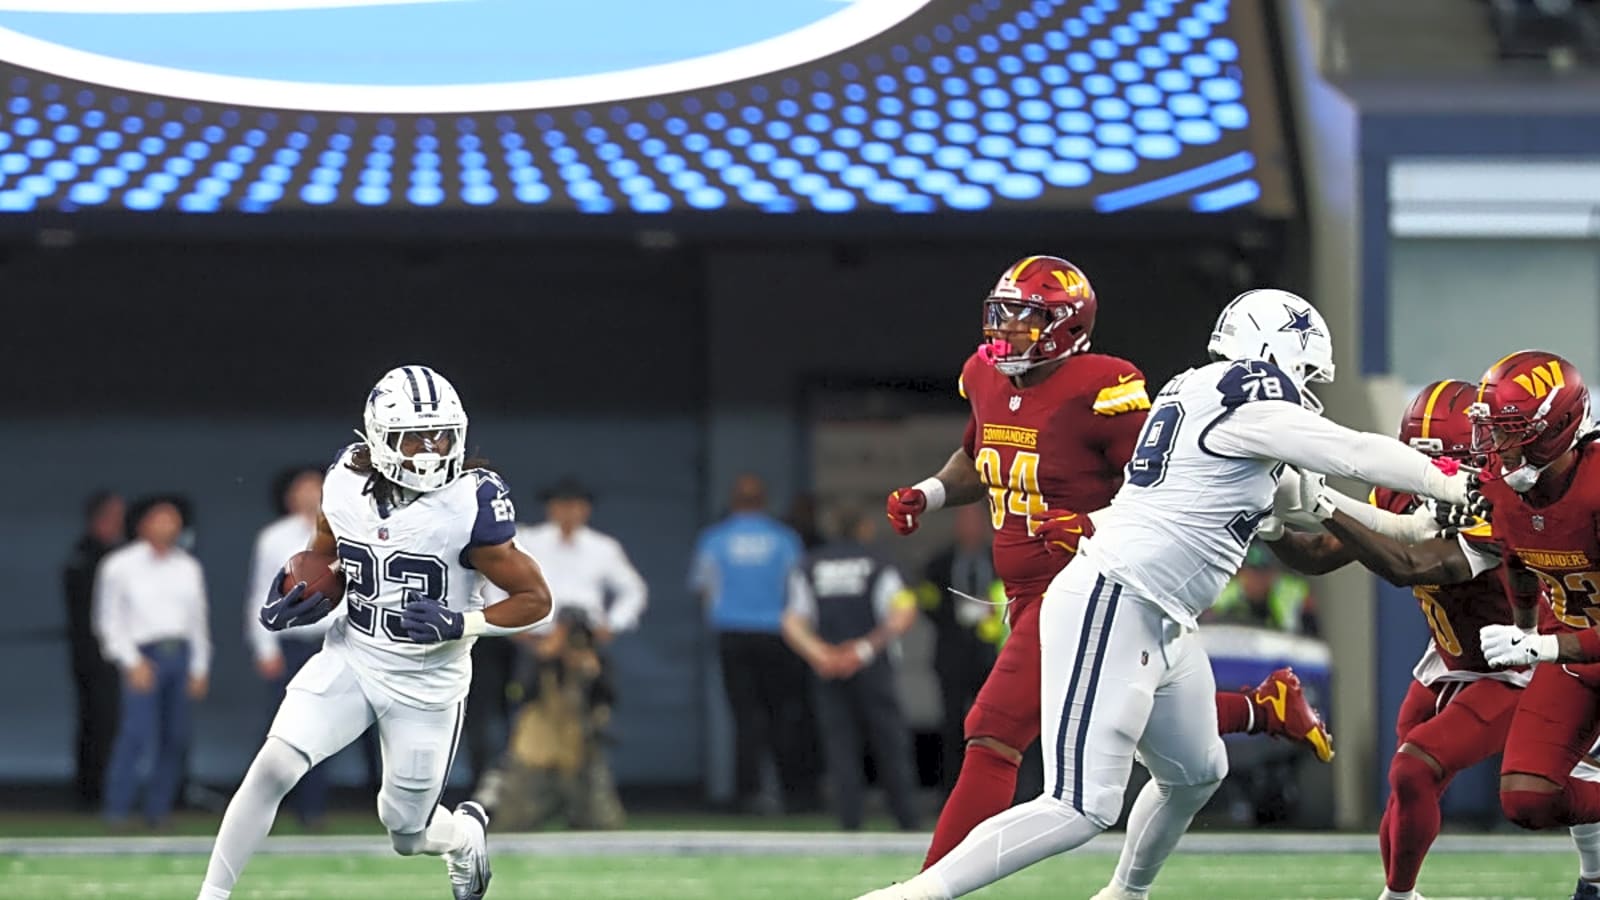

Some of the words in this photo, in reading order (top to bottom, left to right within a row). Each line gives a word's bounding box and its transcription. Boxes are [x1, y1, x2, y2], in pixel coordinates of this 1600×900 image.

[1241, 376, 1283, 401] 78
[983, 428, 1037, 445] COMMANDERS
[336, 536, 449, 643] 23
